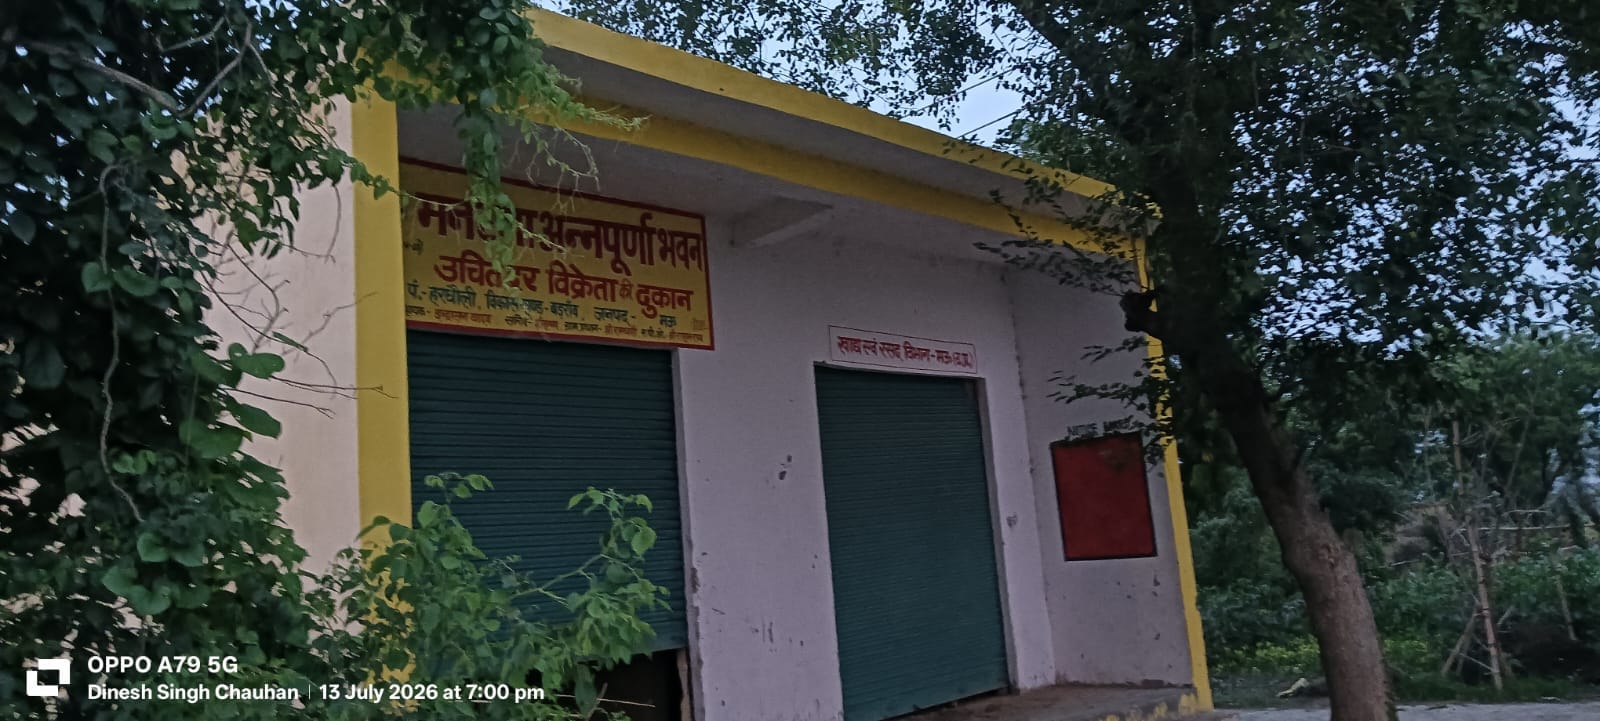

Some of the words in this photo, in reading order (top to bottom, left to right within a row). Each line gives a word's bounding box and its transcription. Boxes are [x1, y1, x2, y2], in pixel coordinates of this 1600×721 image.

[415, 192, 538, 249] मनगा
[539, 211, 656, 276] अन्नपूर्णा
[656, 228, 703, 271] भवन
[433, 249, 506, 288] उचित
[546, 260, 618, 303] विक्रेता
[636, 284, 695, 320] दुकान
